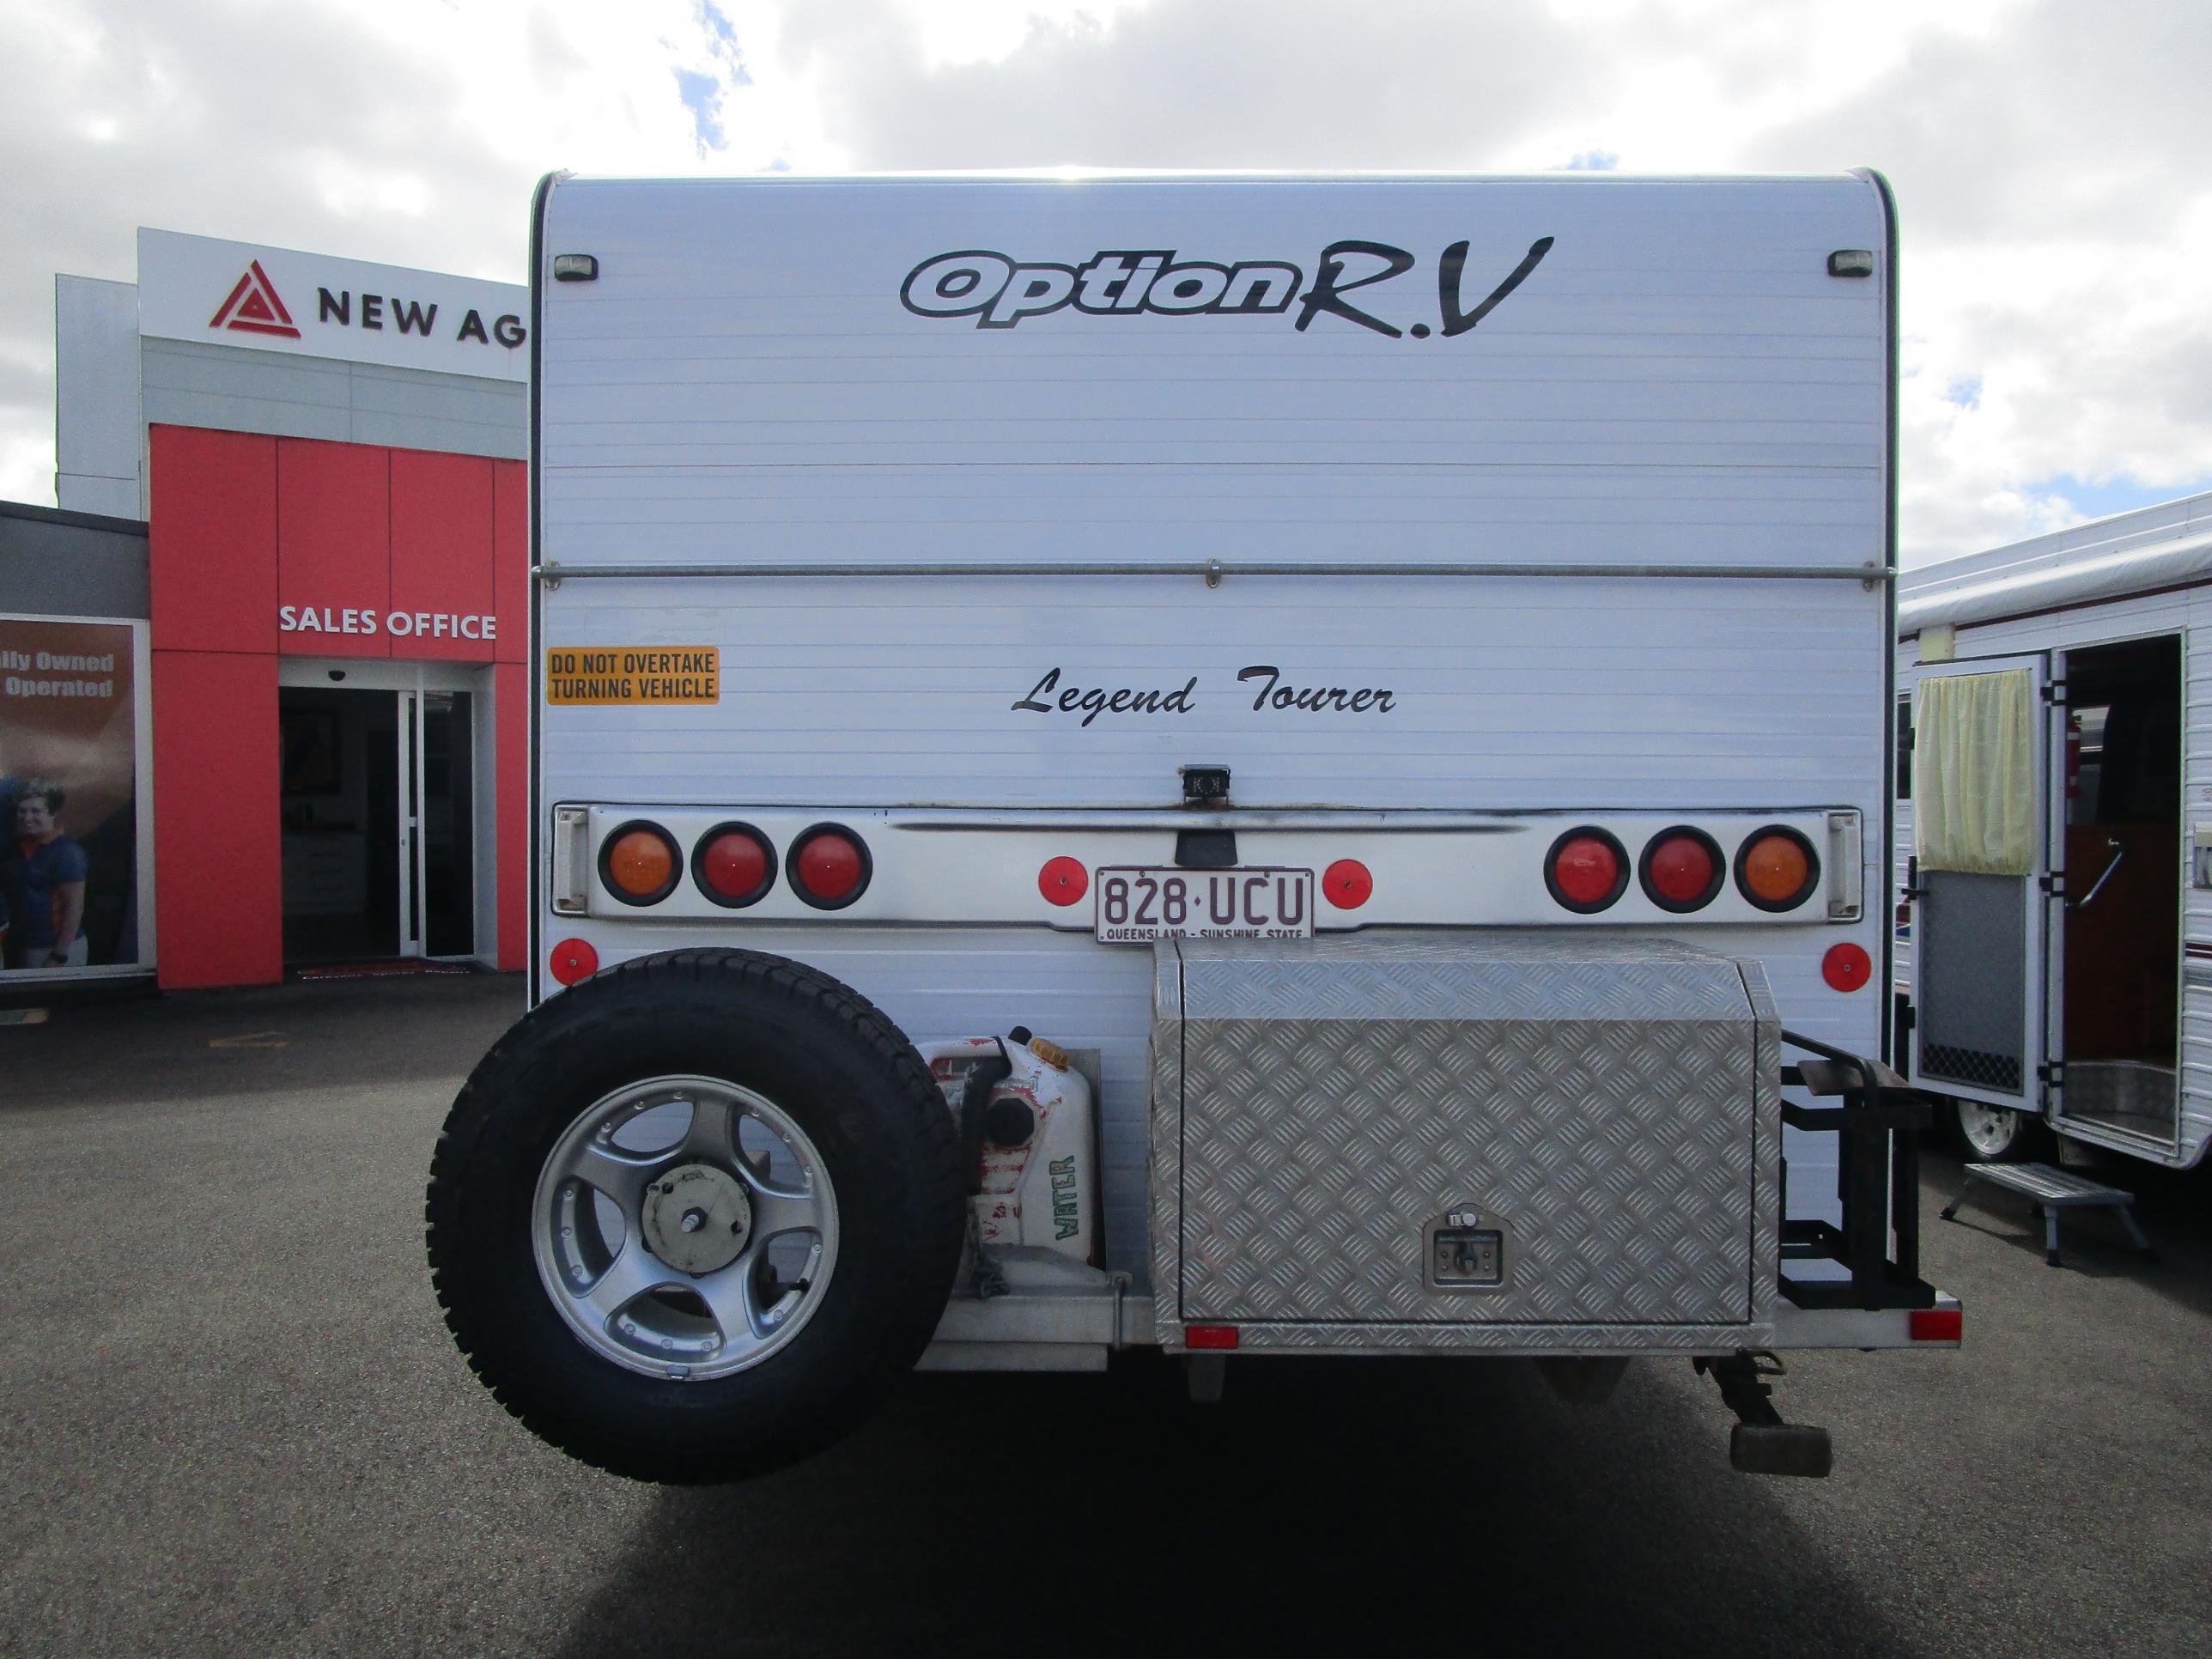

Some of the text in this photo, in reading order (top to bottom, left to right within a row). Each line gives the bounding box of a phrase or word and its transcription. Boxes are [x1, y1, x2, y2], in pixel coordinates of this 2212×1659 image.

[900, 250, 1303, 329] Option
[318, 287, 526, 349] NEW AG
[279, 605, 495, 639] SALES OFFICE
[36, 651, 114, 672] Owned
[551, 653, 714, 674] DO NOT OVERTAKE
[6, 677, 112, 697] Operated
[551, 678, 714, 698] TURNING VEHICLE
[1011, 665, 1397, 726] Legend Tourer
[1107, 928, 1186, 939] QUEENSLAND
[1200, 928, 1260, 938] SUNSHINE
[1267, 929, 1303, 938] STATE
[1049, 1154, 1079, 1240] WATER
